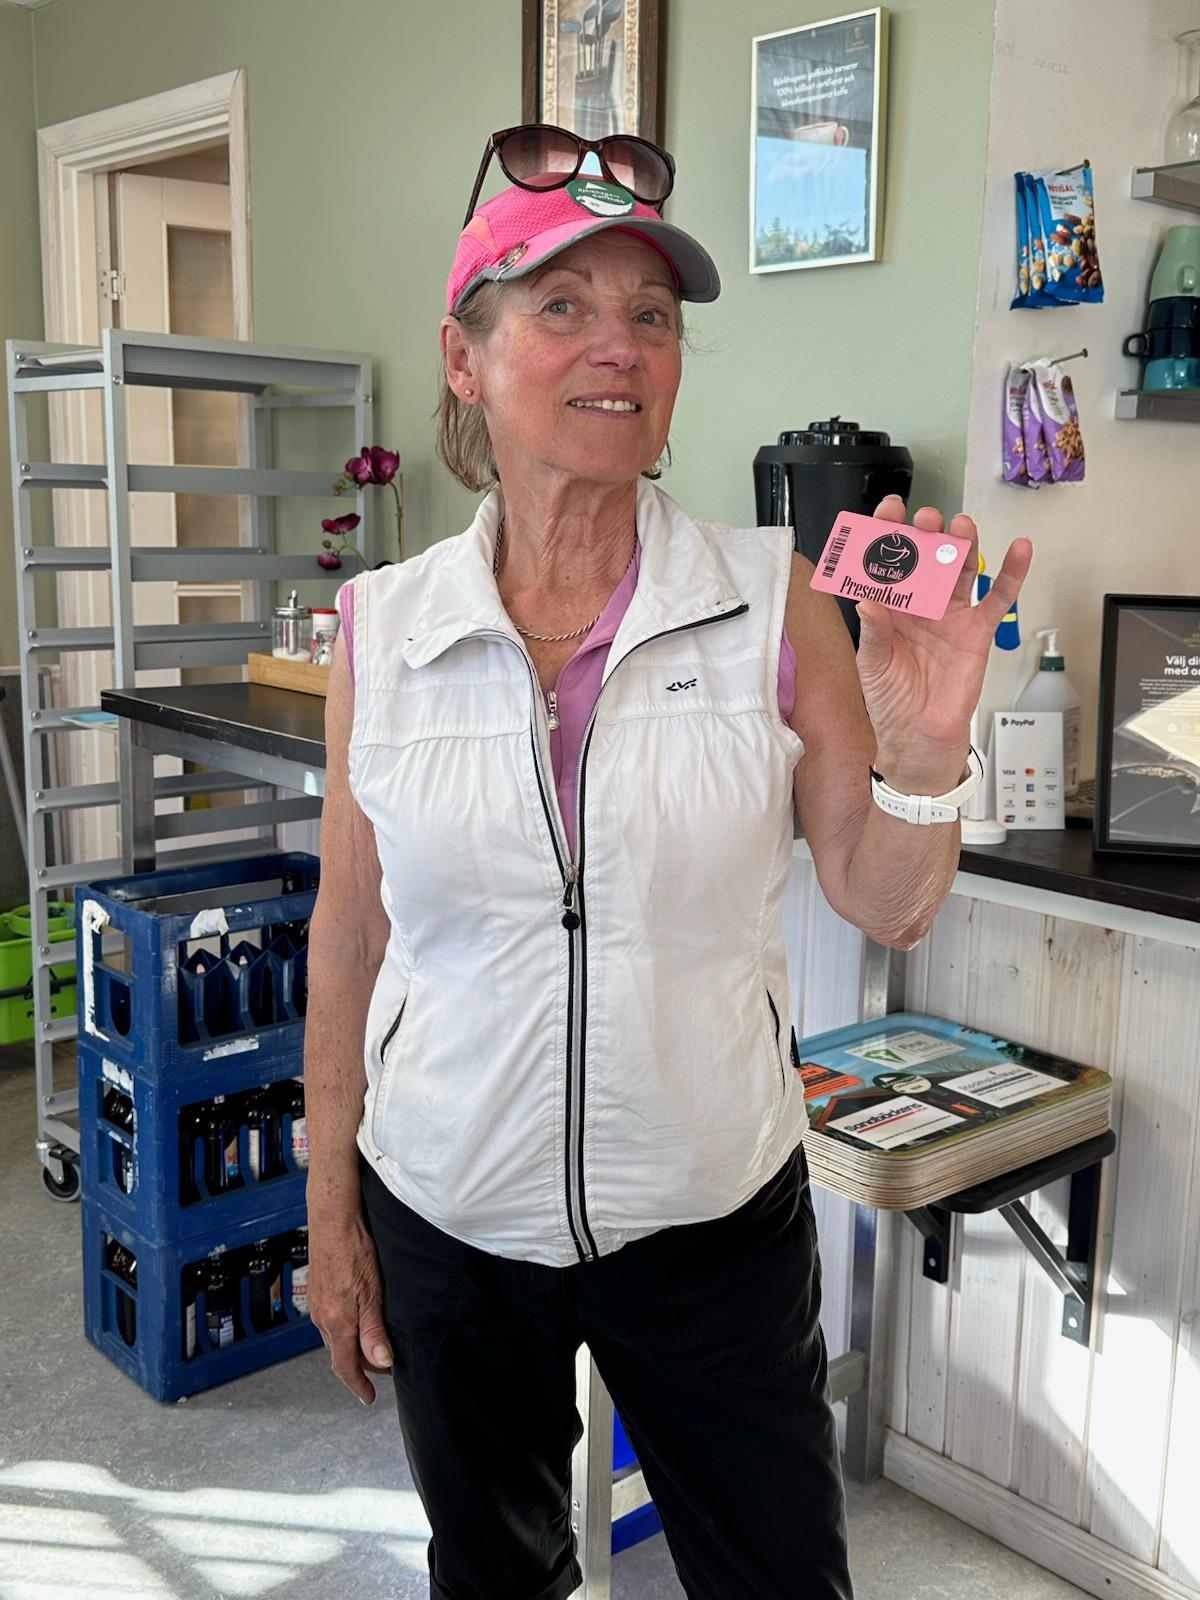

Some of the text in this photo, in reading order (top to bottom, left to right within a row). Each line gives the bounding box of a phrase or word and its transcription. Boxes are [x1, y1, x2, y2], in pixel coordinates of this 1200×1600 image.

[840, 575, 914, 609] Presentkort
[1165, 655, 1200, 667] Välj di
[1164, 666, 1189, 676] med
[1010, 719, 1035, 727] PayPal
